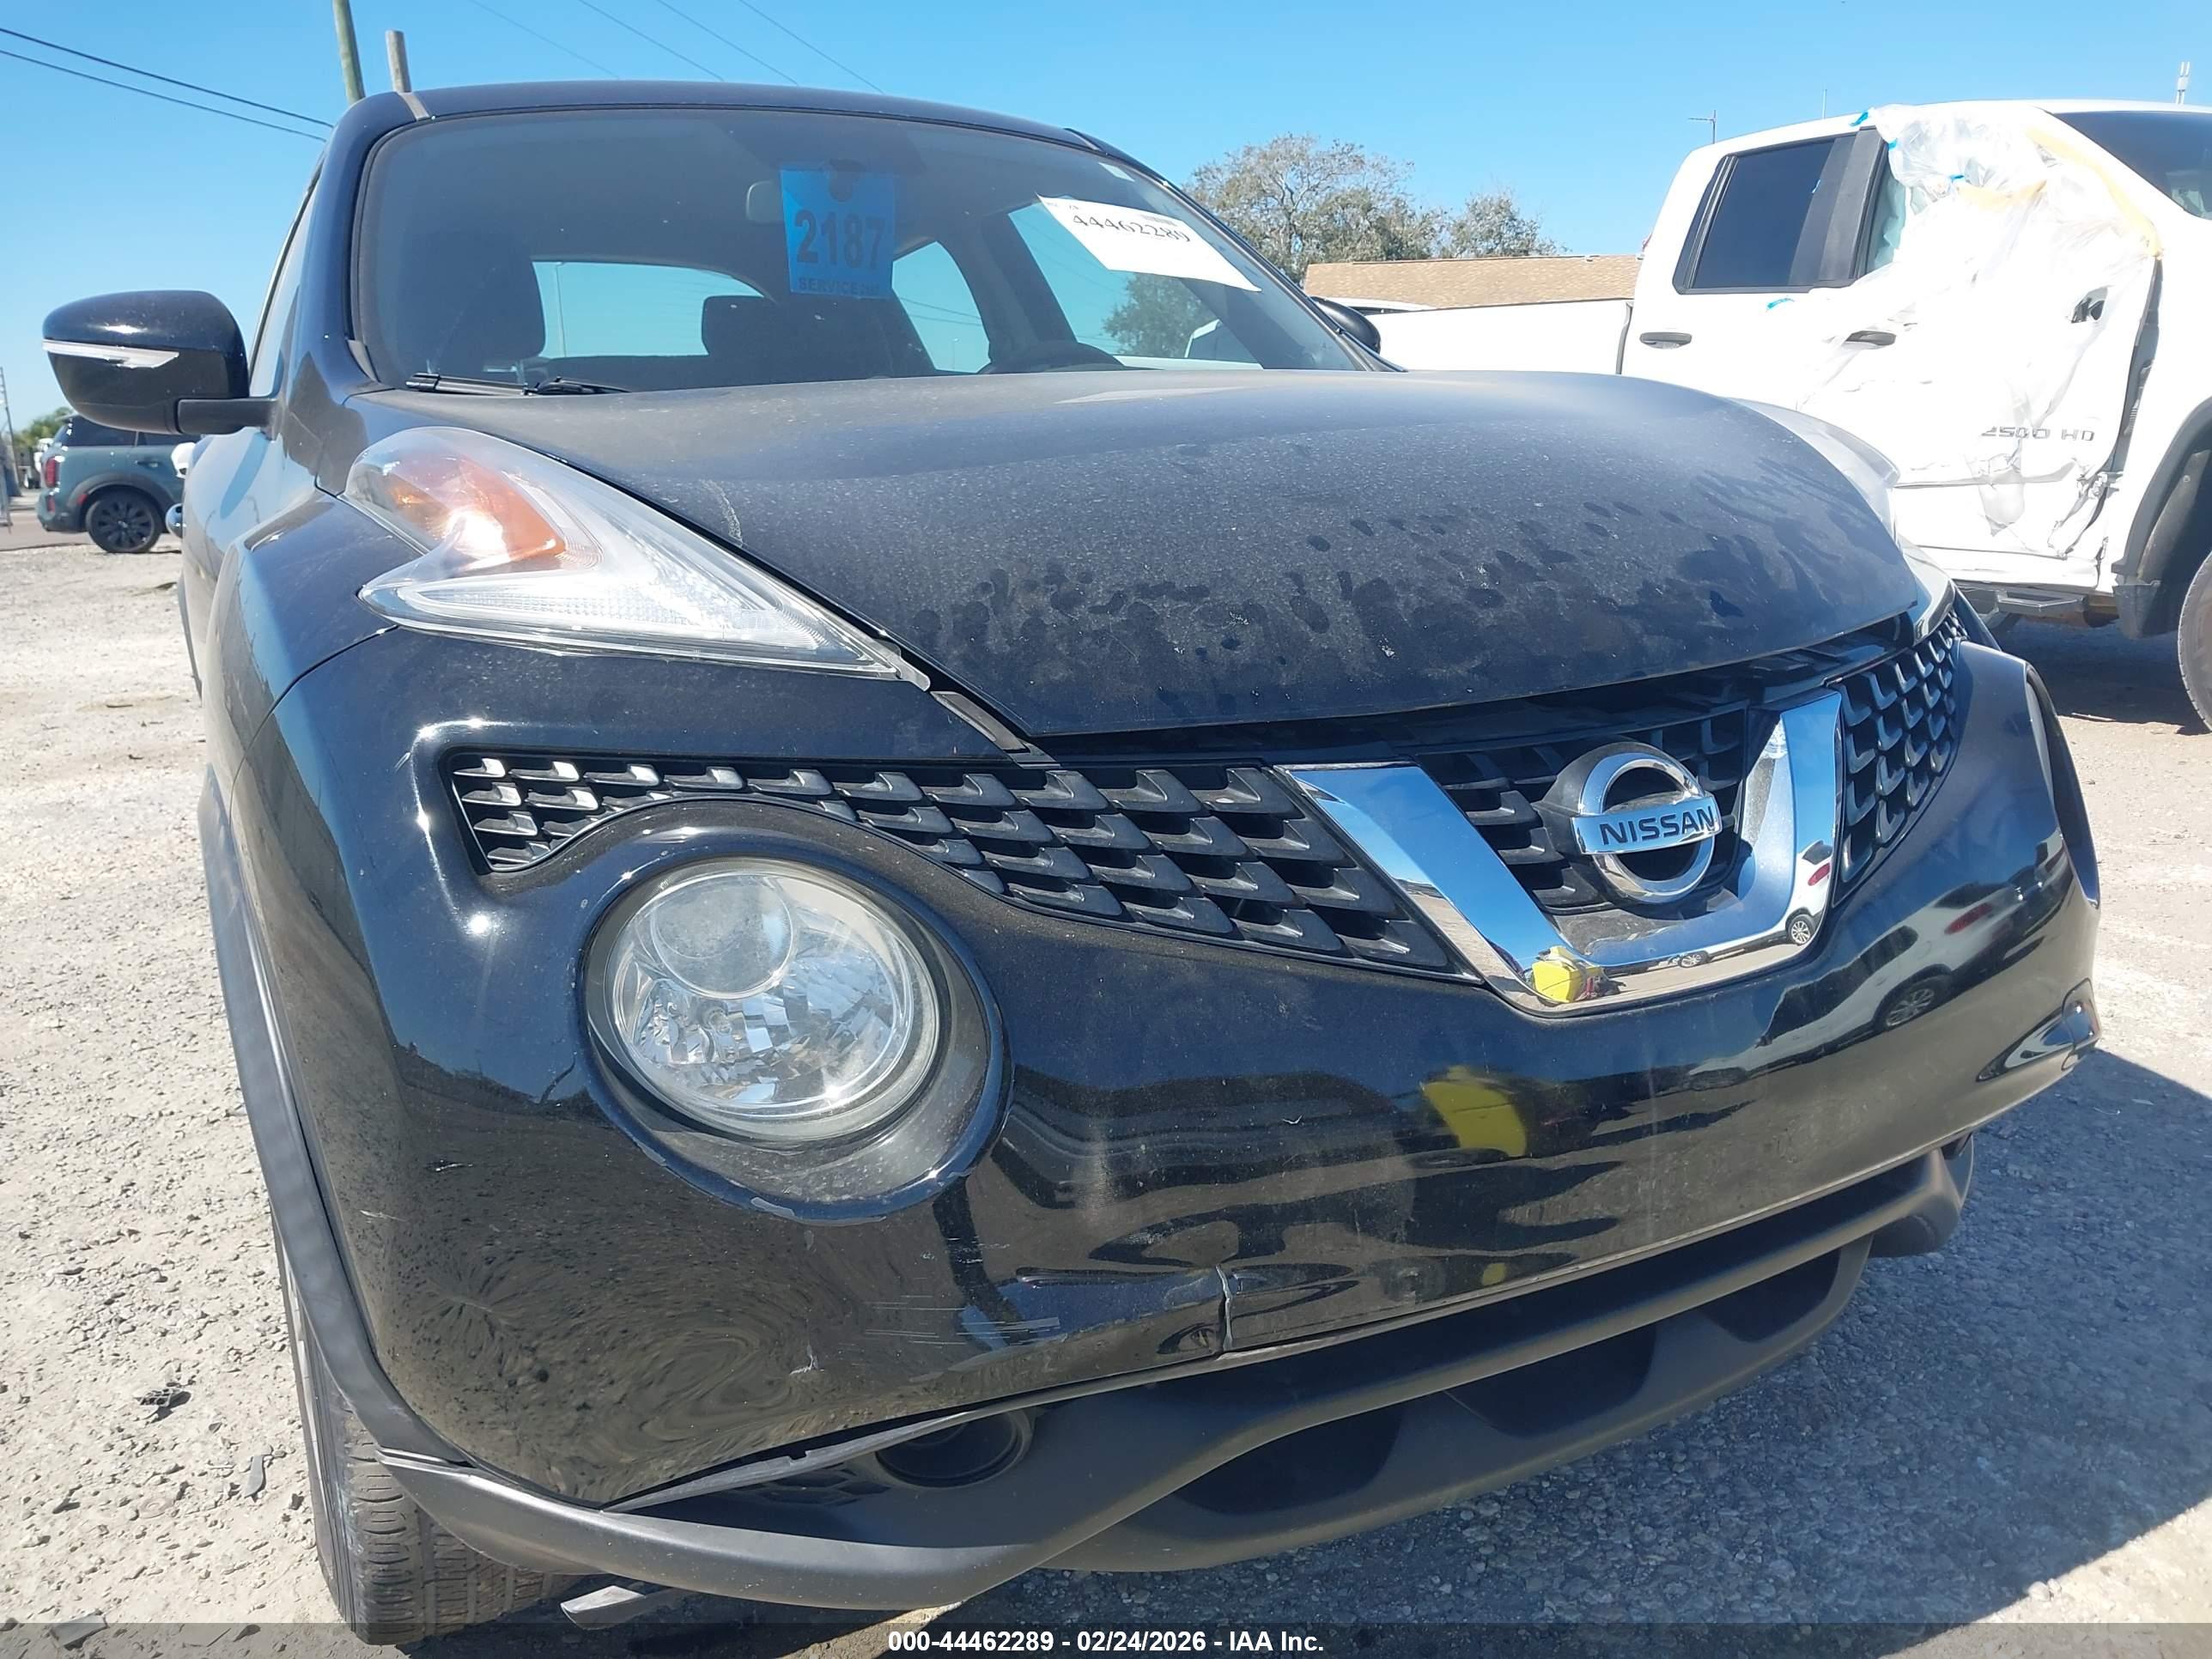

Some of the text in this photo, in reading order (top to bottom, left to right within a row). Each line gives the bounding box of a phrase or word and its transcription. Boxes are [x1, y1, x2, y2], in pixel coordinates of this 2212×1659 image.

[794, 209, 885, 270] 2187
[1073, 215, 1191, 242] 44462289
[1980, 426, 2095, 441] 2500 HD
[1599, 805, 1715, 846] NISSAN
